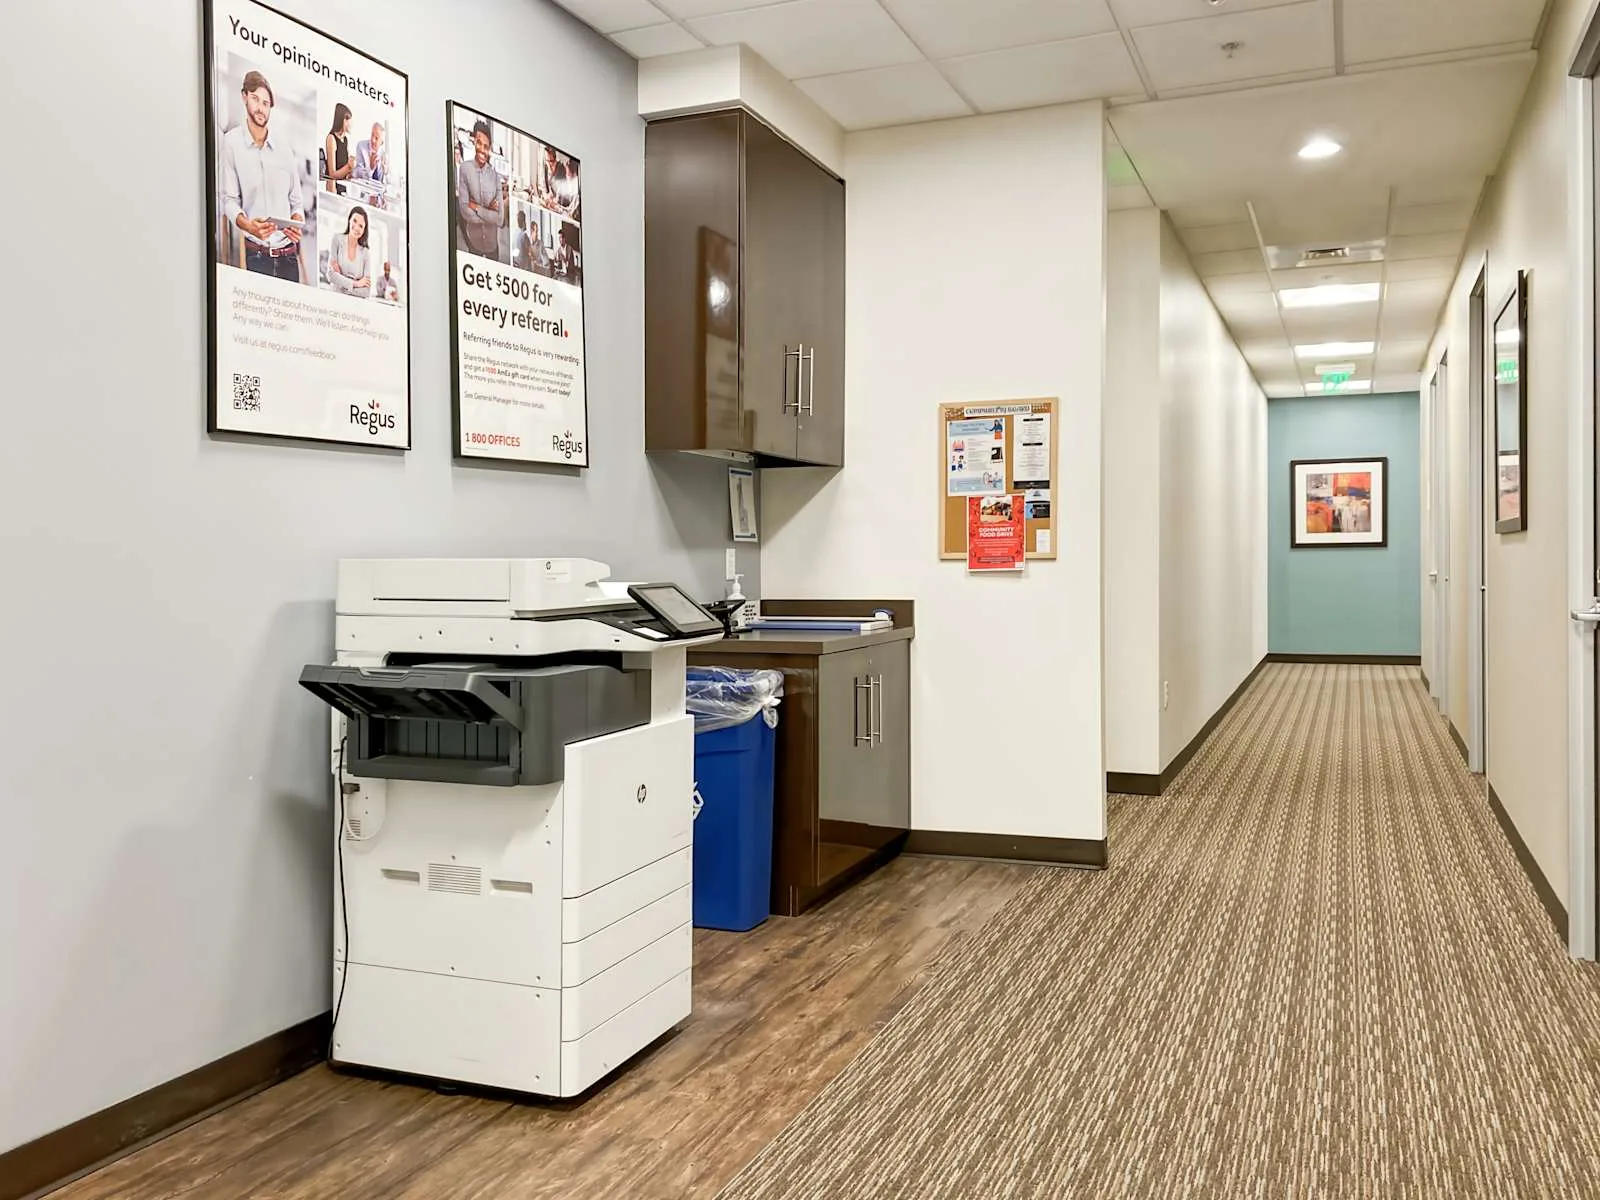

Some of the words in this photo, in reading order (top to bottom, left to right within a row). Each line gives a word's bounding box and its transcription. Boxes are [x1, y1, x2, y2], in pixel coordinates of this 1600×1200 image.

[228, 15, 268, 49] Your
[272, 42, 330, 78] opinion
[334, 69, 395, 107] matters.
[462, 263, 492, 291] Get
[496, 273, 529, 300] $500
[533, 284, 552, 306] for
[248, 291, 280, 305] thoughts
[282, 299, 301, 309] about
[274, 308, 293, 320] Share
[463, 300, 507, 329] every
[512, 311, 568, 338] referral.
[463, 331, 491, 348] Referring
[492, 338, 512, 350] friends
[513, 343, 519, 351] to
[520, 344, 536, 356] Regus
[543, 351, 554, 360] very
[350, 402, 395, 435] Regus
[465, 432, 470, 442] 1
[472, 433, 487, 444] 800
[488, 434, 520, 447] OFFICES
[552, 434, 583, 459] Regus
